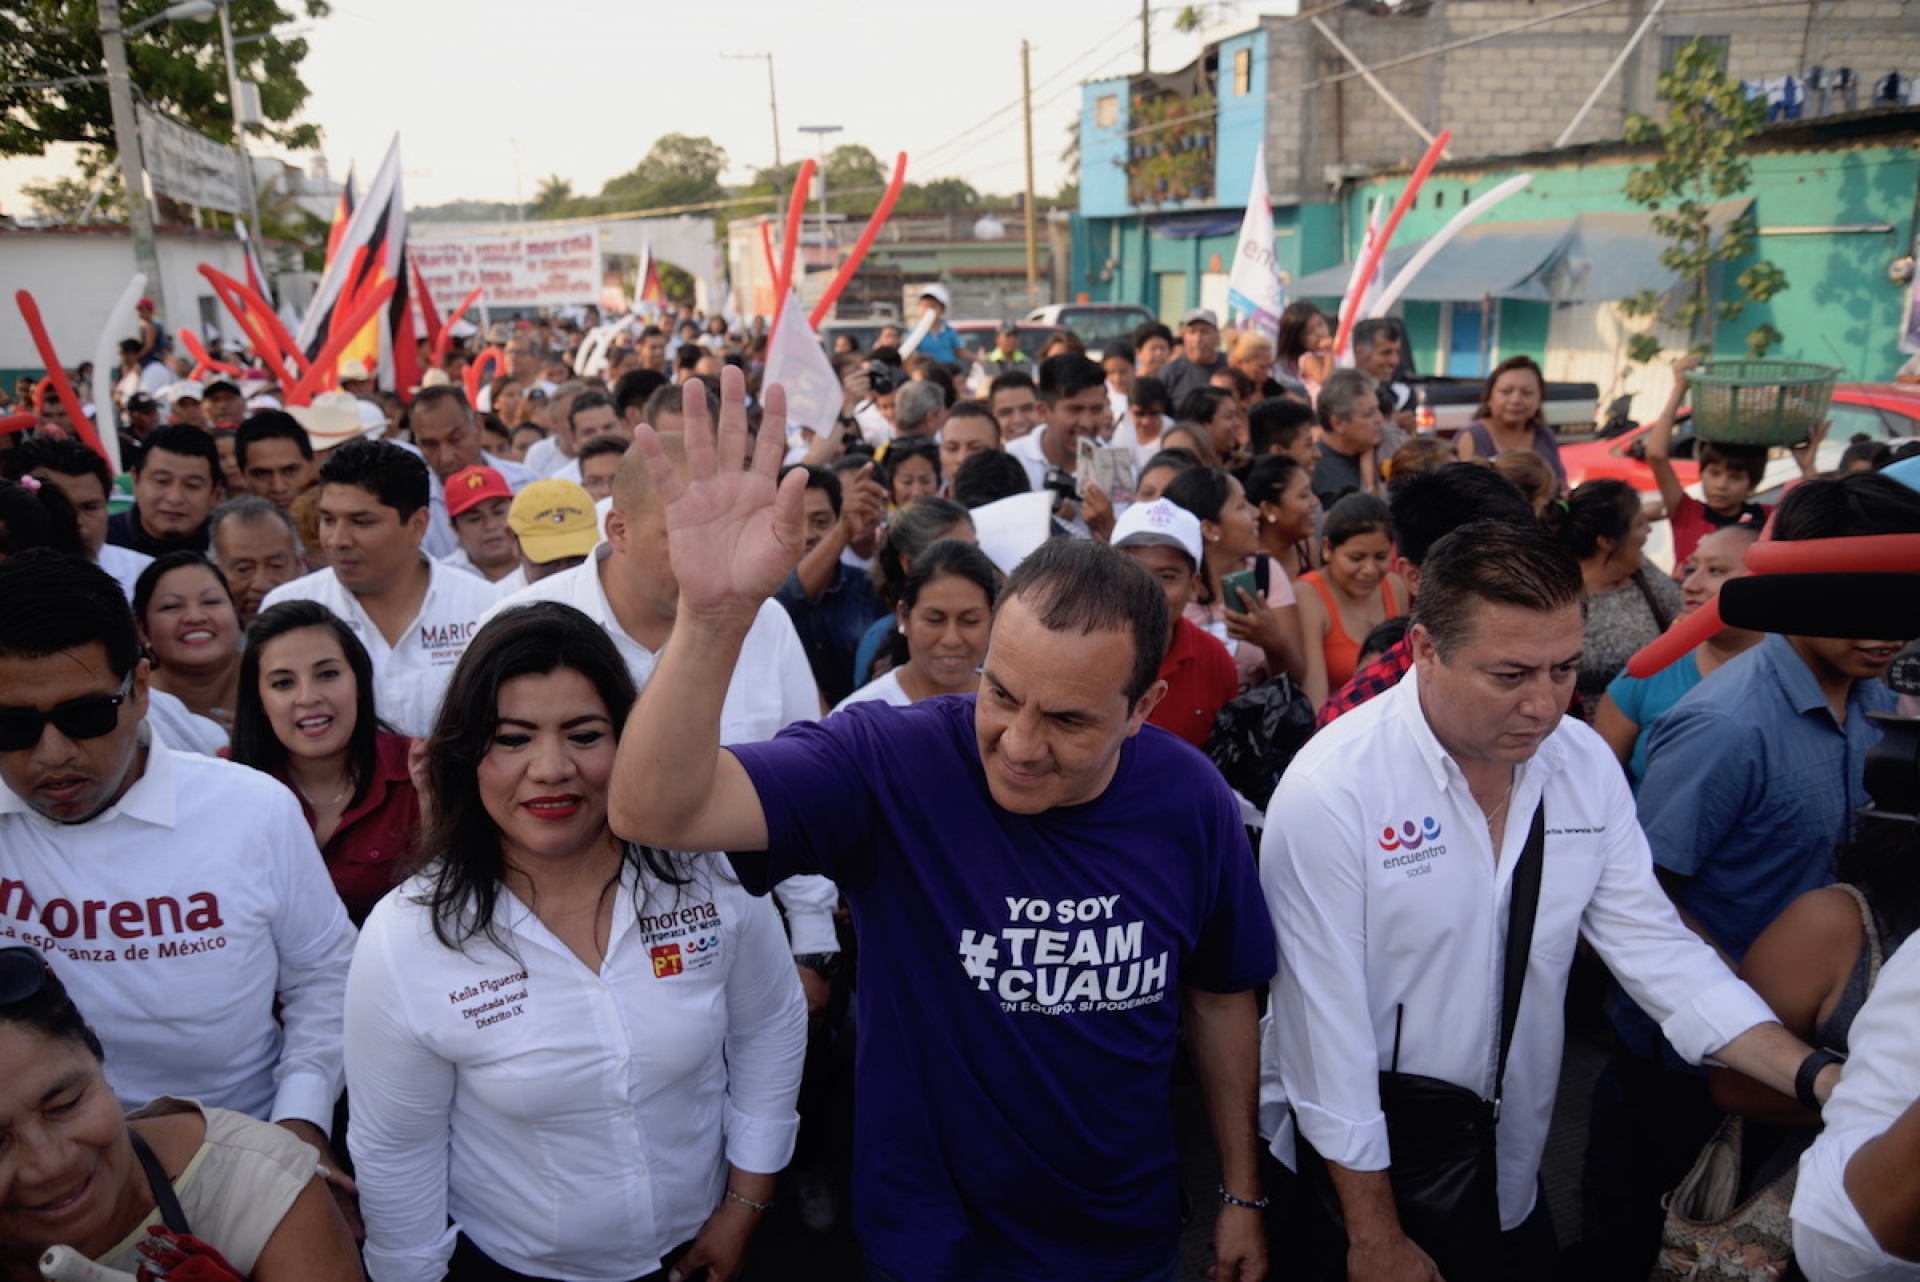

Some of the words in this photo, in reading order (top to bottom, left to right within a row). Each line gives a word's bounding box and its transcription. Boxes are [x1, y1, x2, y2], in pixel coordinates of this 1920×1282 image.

[1383, 844, 1447, 870] encuentro
[640, 902, 718, 933] morena
[1005, 897, 1051, 922] YO
[1056, 894, 1120, 924] SOY
[124, 943, 149, 961] de
[158, 935, 227, 959] México
[655, 953, 683, 976] PT
[998, 951, 1169, 1006] CUAUH
[462, 997, 505, 1020] Diputada
[505, 988, 528, 1004] local
